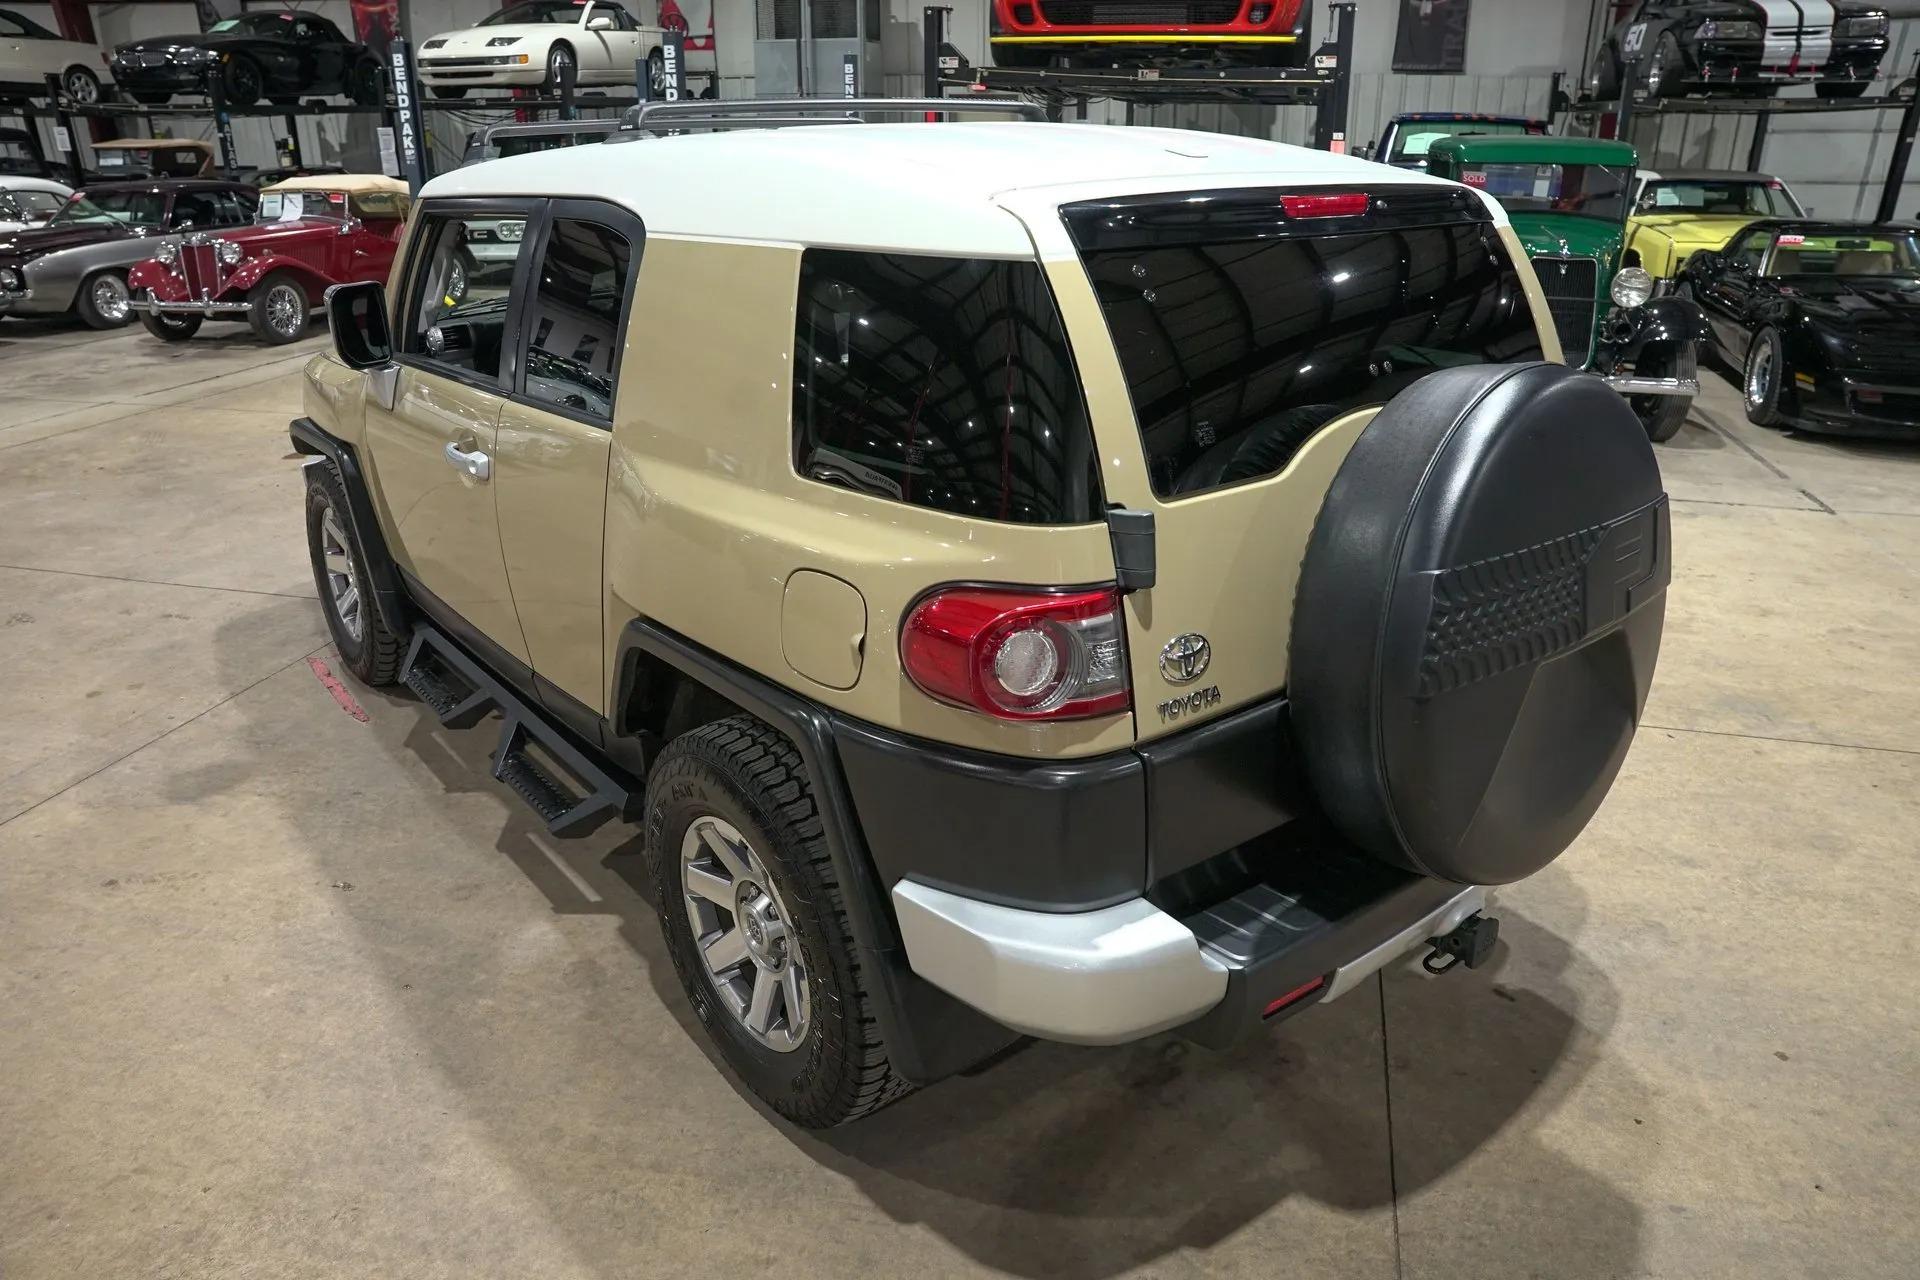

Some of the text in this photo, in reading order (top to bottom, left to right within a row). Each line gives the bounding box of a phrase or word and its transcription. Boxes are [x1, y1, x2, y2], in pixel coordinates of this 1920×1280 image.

[1624, 23, 1648, 52] 50
[392, 53, 415, 149] BENDPAK
[224, 124, 238, 169] ATLAS
[1463, 175, 1486, 183] SOLD
[1155, 684, 1222, 718] TOYOTA
